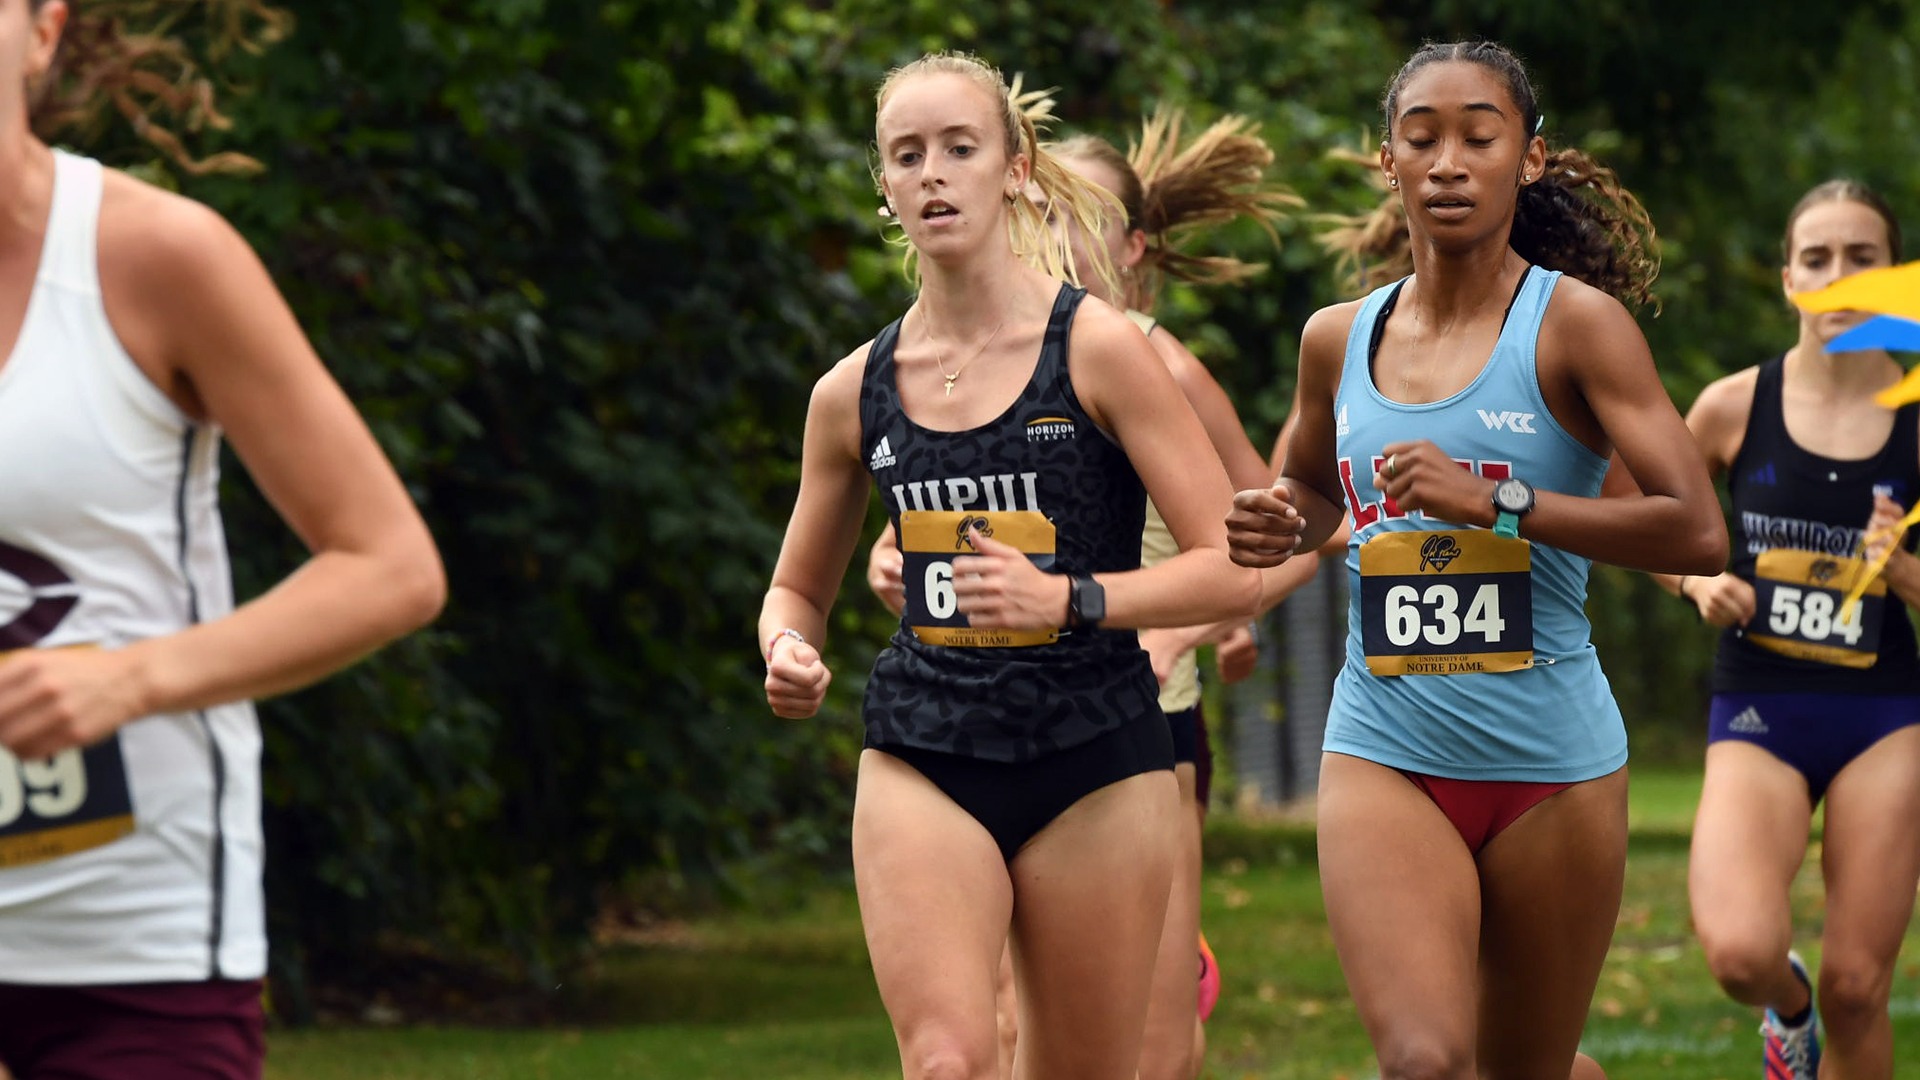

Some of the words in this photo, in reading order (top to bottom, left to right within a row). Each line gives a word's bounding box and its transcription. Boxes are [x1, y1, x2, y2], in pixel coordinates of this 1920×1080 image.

[1026, 424, 1075, 436] HORIZON
[1476, 409, 1538, 434] WCC
[1384, 583, 1506, 647] 634
[1768, 585, 1864, 646] 584
[943, 635, 976, 645] NOTRE
[980, 635, 1011, 645] DAME
[1406, 662, 1444, 672] NOTRE
[1448, 661, 1485, 672] DAME
